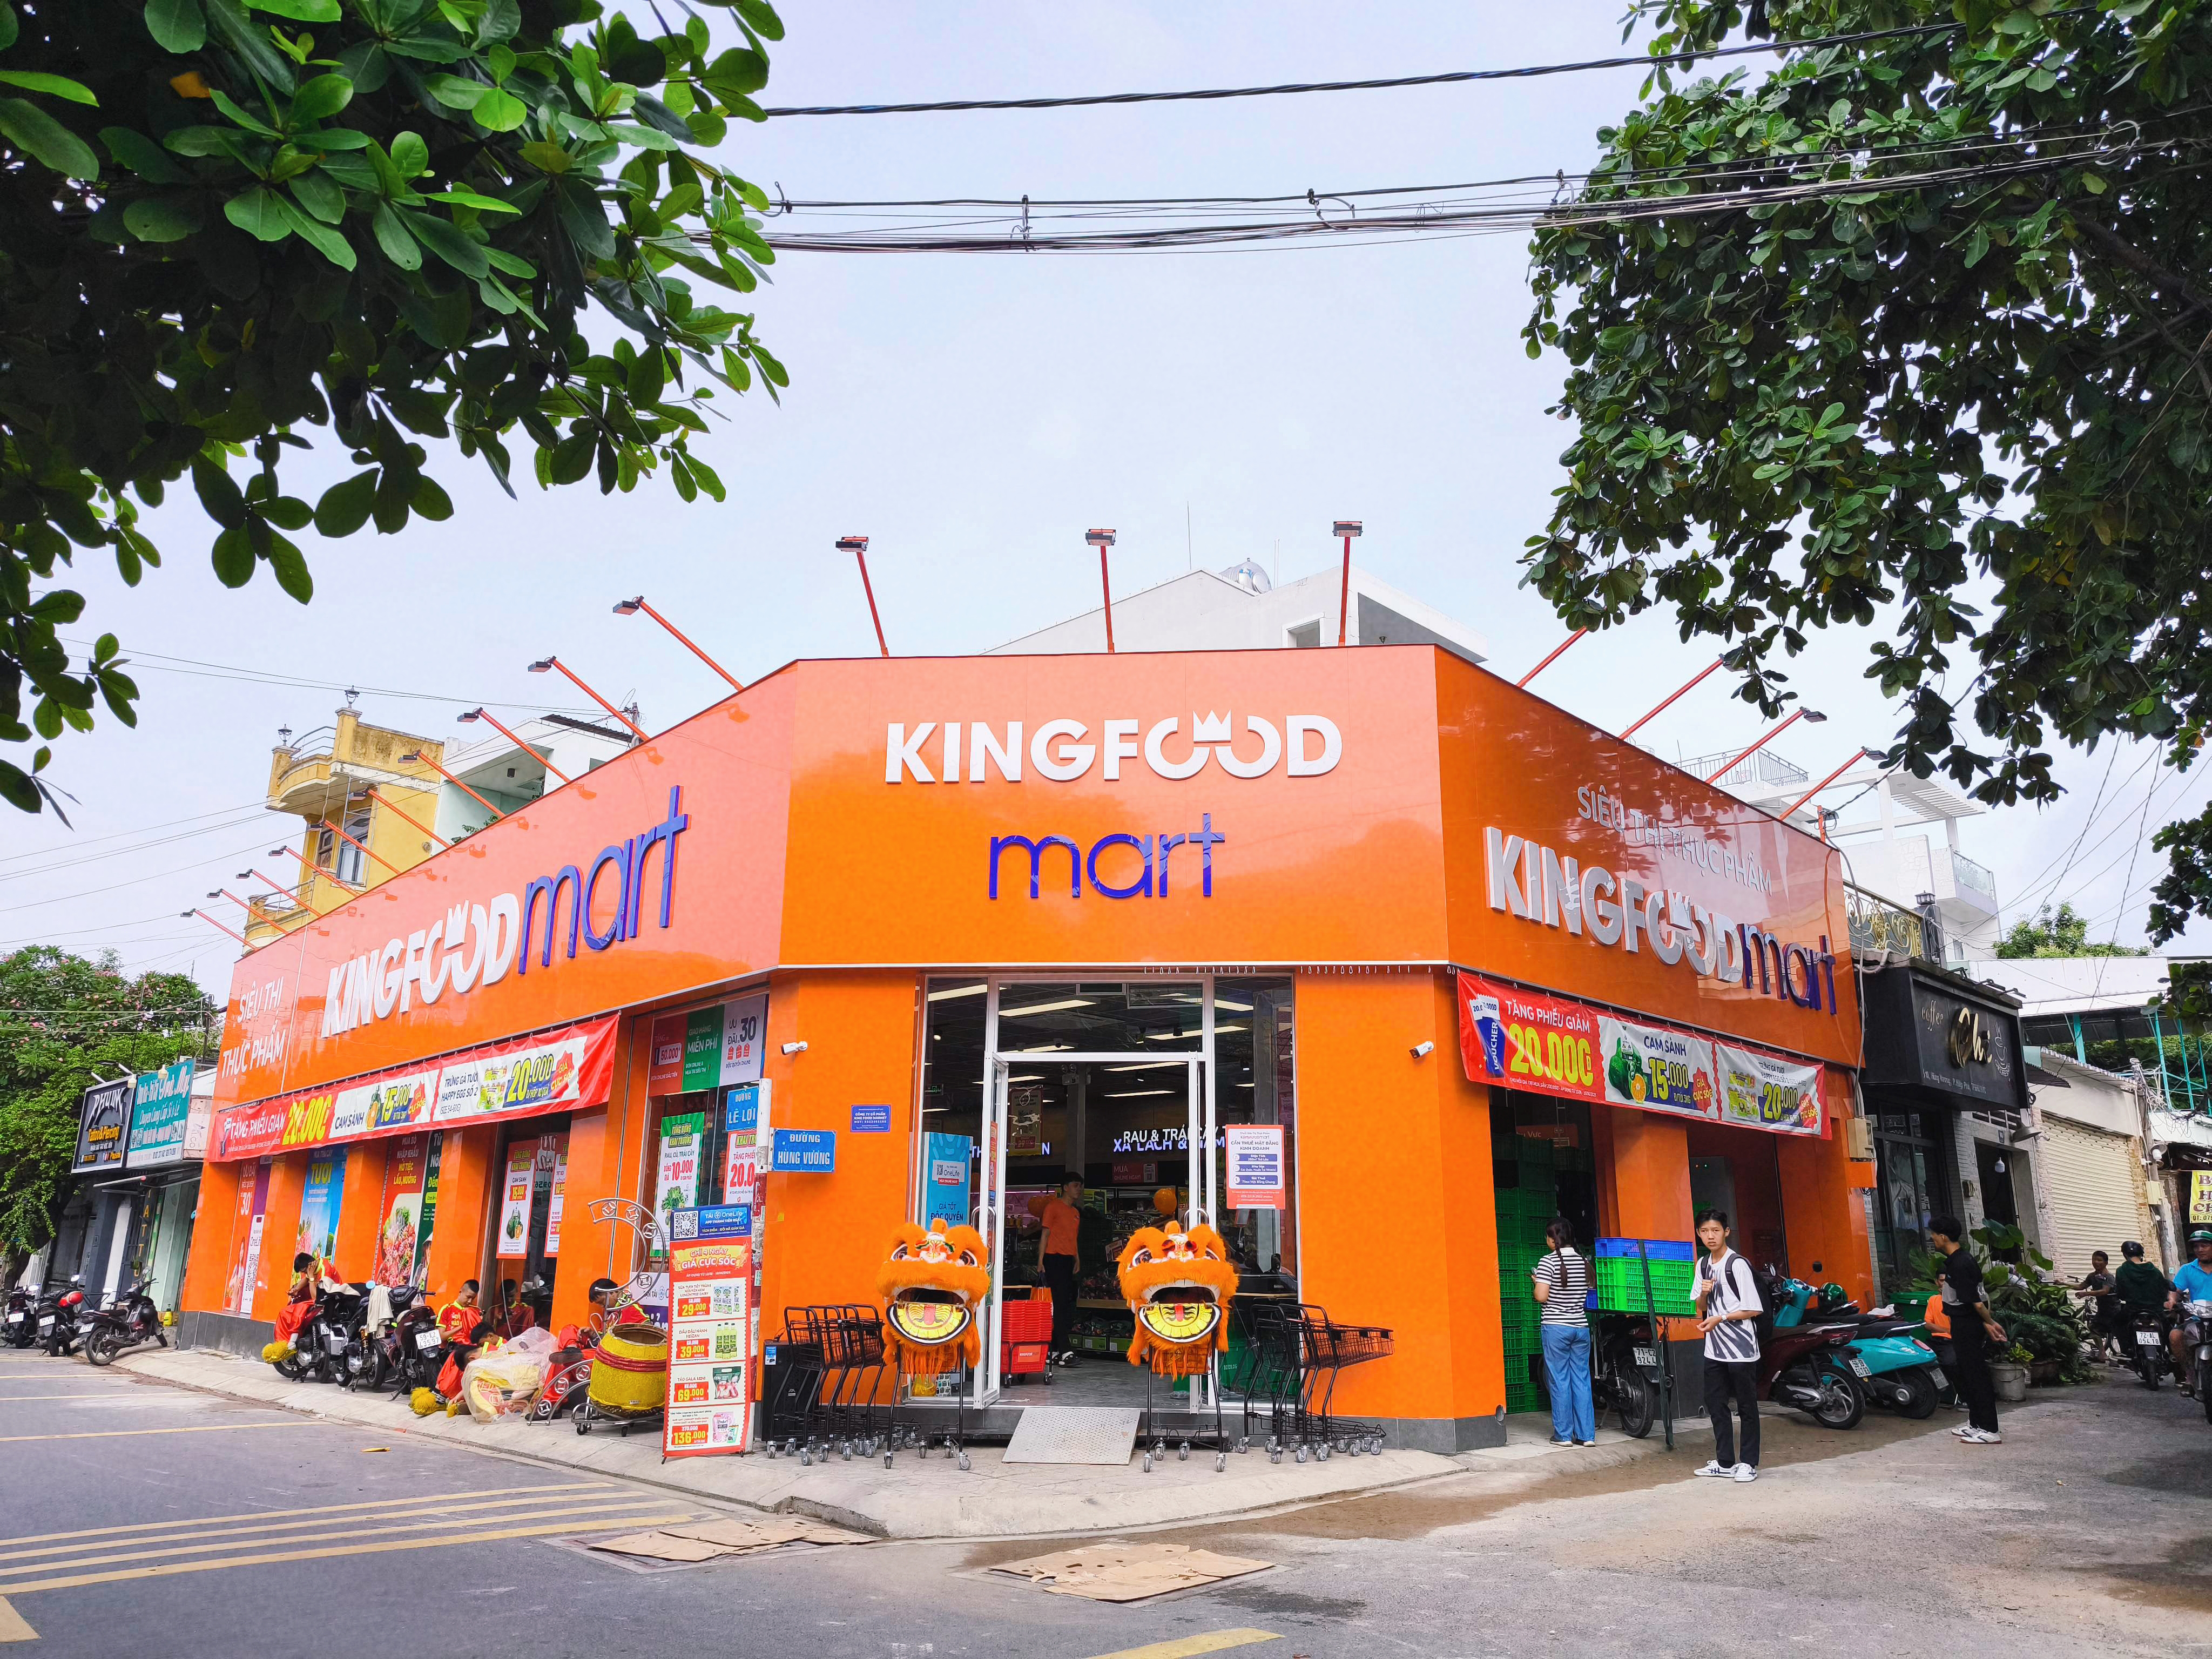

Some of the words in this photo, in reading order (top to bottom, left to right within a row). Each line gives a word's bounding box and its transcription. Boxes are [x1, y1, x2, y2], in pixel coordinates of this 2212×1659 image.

[885, 711, 1343, 784] KINGFOOD
[1577, 785, 1624, 832] SIÊU
[1629, 808, 1665, 860] THỊ
[1668, 825, 1720, 877] THỰC
[989, 812, 1225, 899] mart
[237, 980, 262, 1023] SIÊU
[263, 976, 284, 1016] THỊ
[1506, 998, 1534, 1024] TẶNG
[1536, 1007, 1563, 1028] PHIẾU
[1566, 1013, 1590, 1034] GIẢM
[1921, 1000, 1944, 1031] coffee
[689, 1028, 698, 1036] GIAO
[729, 1019, 737, 1029] ƯU
[687, 1036, 704, 1054] MIỄN
[705, 1033, 718, 1050] PHÍ
[1491, 1022, 1499, 1070] VOUCHER
[1644, 1036, 1663, 1051] CAM
[1665, 1037, 1686, 1056] SÀNH
[507, 1054, 554, 1102] 20.000
[1648, 1057, 1689, 1100] 15.000
[442, 1090, 456, 1102] HAPPY
[456, 1089, 466, 1099] EGG
[474, 1087, 478, 1096] 2
[1763, 1082, 1798, 1121] 20.000
[381, 1083, 411, 1123] 15.000
[335, 1115, 348, 1129] CAM
[729, 1108, 739, 1124] LÊ
[741, 1107, 756, 1124] LỢI
[790, 1132, 820, 1143] ĐƯỜNG
[1123, 1130, 1148, 1143] RAU
[1151, 1129, 1159, 1142] &
[1178, 1138, 1187, 1149] &
[778, 1148, 800, 1165] HÙNG
[803, 1149, 830, 1165] VƯƠNG
[672, 1159, 693, 1181] 10.000
[948, 1201, 956, 1210] TỐT
[945, 1210, 963, 1223] QUYỀN
[709, 1246, 728, 1255] NGÀY
[682, 1258, 697, 1270] GIÁ
[699, 1257, 718, 1269] CỰC
[718, 1254, 736, 1266] SỐC
[682, 1303, 706, 1316] 29.000
[680, 1345, 705, 1358] 39.000
[1636, 1348, 1656, 1357] 71-C2
[678, 1388, 704, 1401] 69.000
[673, 1431, 706, 1444] 136.000
